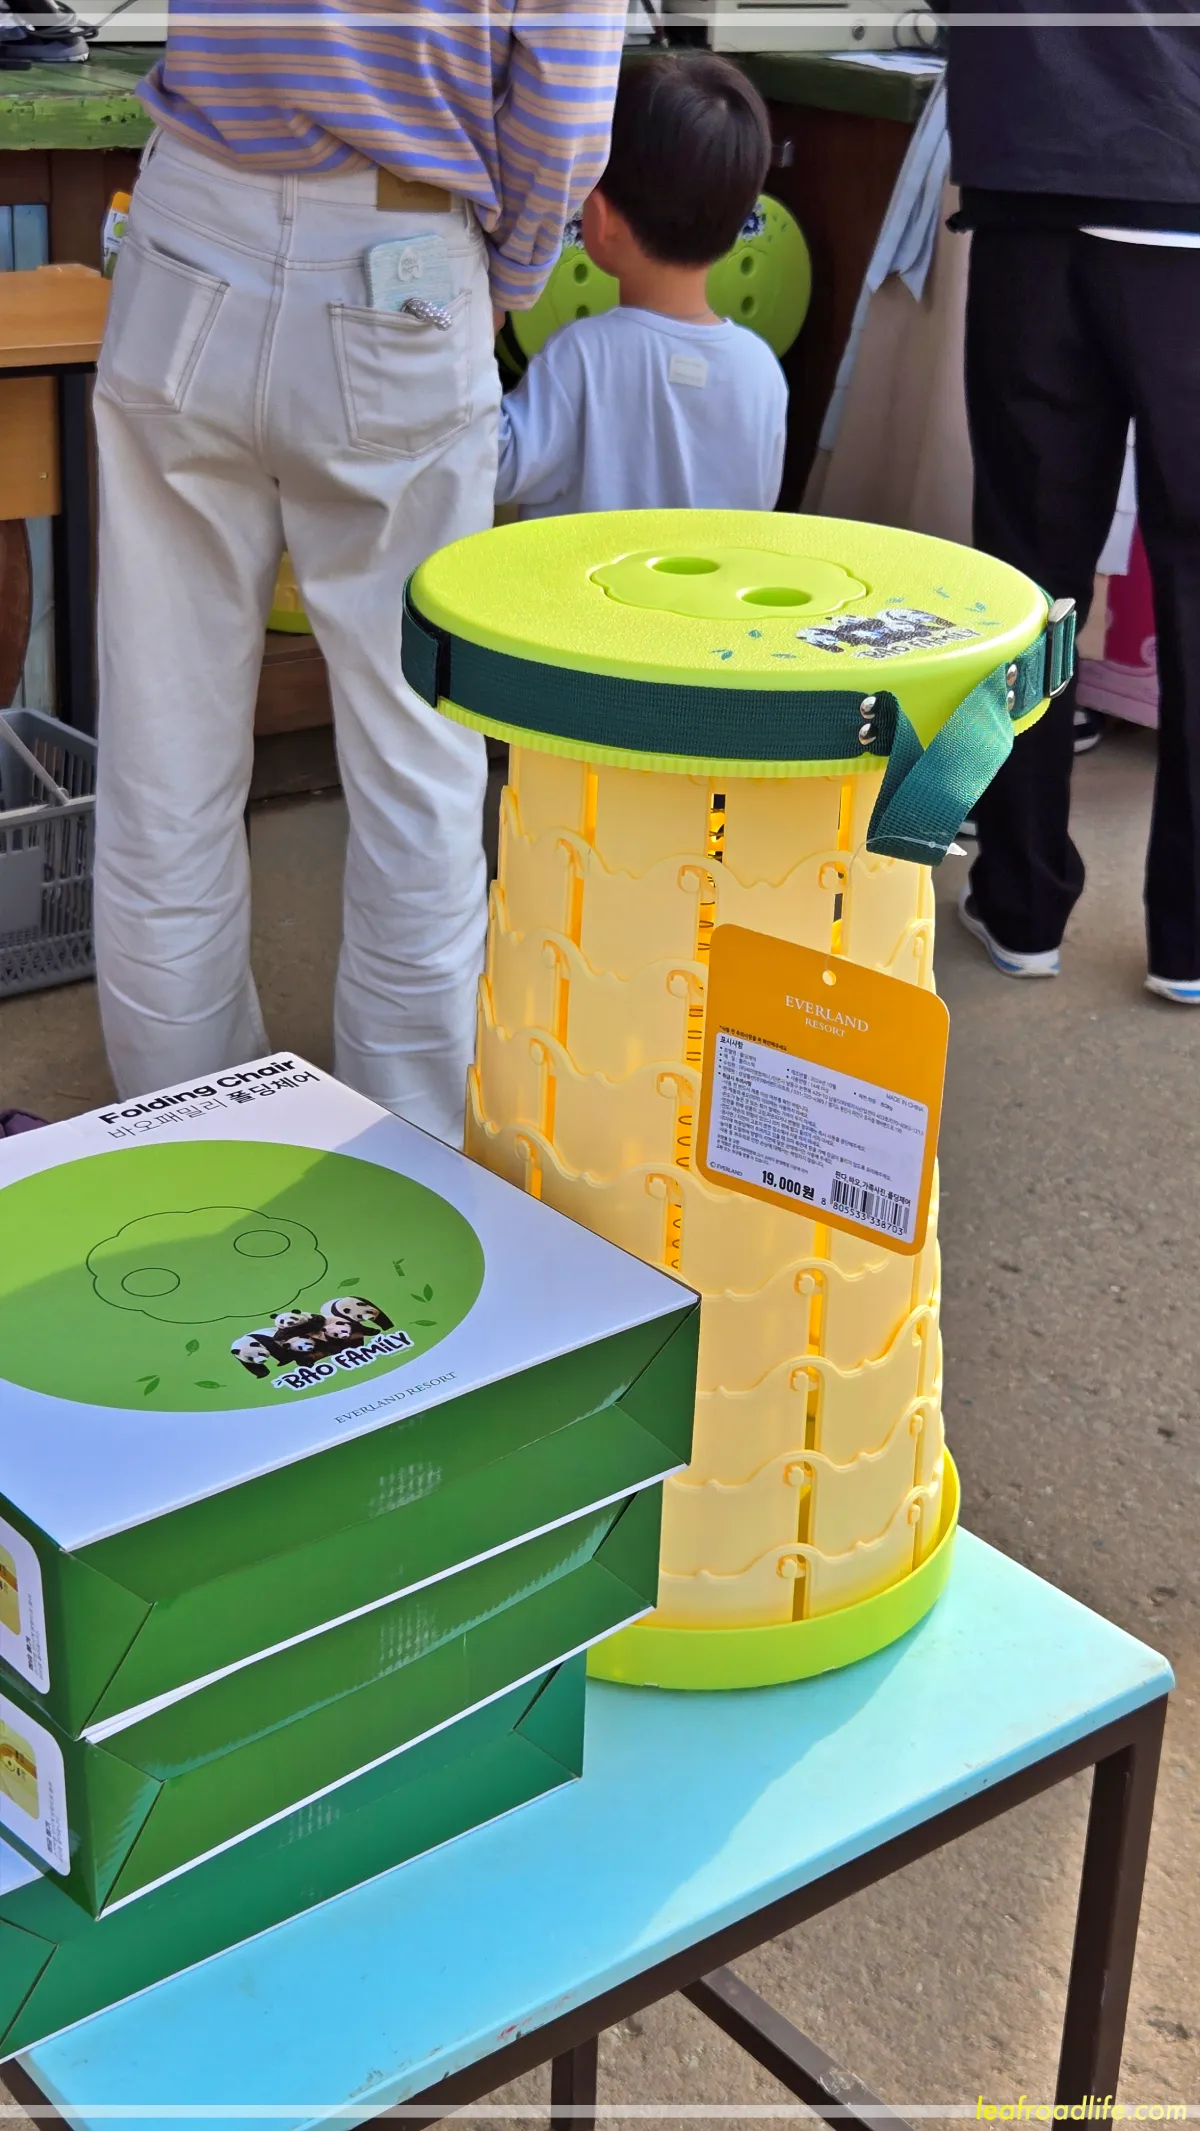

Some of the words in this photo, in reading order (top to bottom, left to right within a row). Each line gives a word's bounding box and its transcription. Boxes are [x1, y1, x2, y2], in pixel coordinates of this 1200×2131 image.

[785, 994, 869, 1032] EVERLAND
[805, 1018, 846, 1037] RESORT
[720, 1035, 744, 1050] 표시사항
[98, 1084, 218, 1125] Folding
[216, 1060, 296, 1088] Chair
[108, 1098, 228, 1139] 바오패밀리
[226, 1070, 321, 1104] 폴딩체어
[716, 1163, 743, 1177] EVERLAND
[761, 1170, 815, 1201] 19,000원
[833, 1202, 866, 1221] 805533
[870, 1216, 904, 1236] 338703
[282, 1363, 335, 1389] BAO
[334, 1332, 412, 1369] FAMILY
[334, 1391, 406, 1424] EVERLAND
[404, 1371, 458, 1396] RESORT
